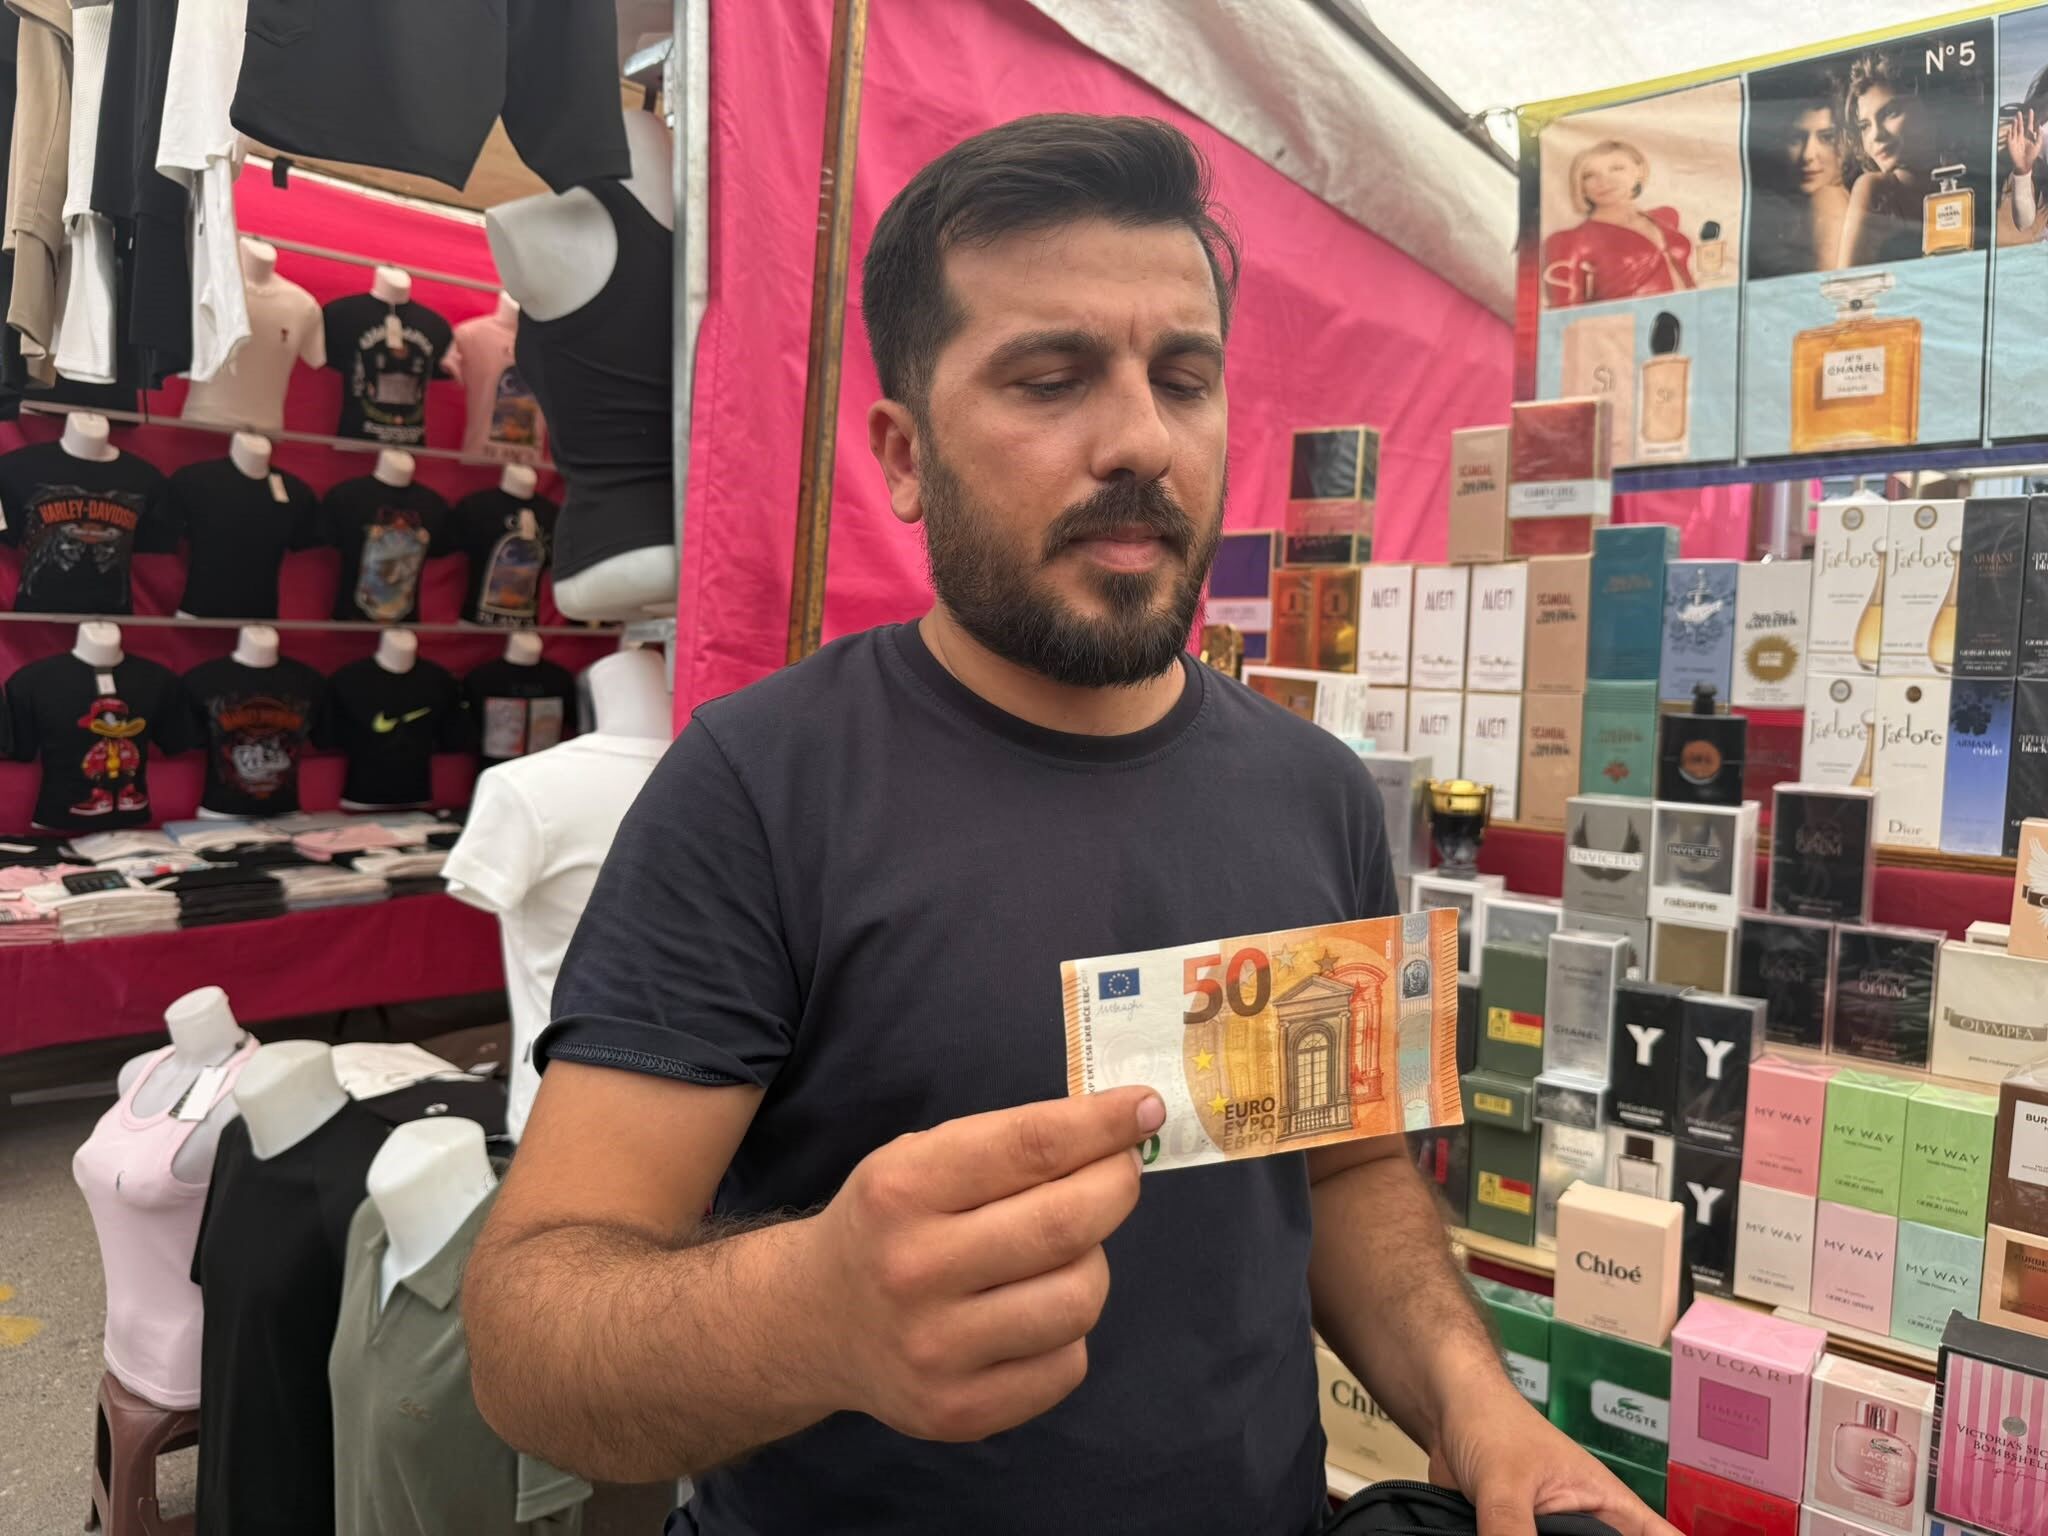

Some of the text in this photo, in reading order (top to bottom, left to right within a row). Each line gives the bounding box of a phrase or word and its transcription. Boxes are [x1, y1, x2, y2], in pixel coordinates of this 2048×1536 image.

[1826, 362, 1881, 377] CHANEL
[1888, 819, 1923, 836] Dior
[1663, 896, 1718, 911] rabanne
[1182, 947, 1272, 1025] 50
[1858, 983, 1908, 999] OPIUM
[1552, 1023, 1602, 1041] CHANEL
[1625, 1023, 1665, 1066] Y
[1696, 1036, 1736, 1081] Y
[1225, 1096, 1276, 1120] EURO
[1754, 1106, 1812, 1125] MY WAY
[1833, 1123, 1894, 1144] MY WAY
[1915, 1143, 1980, 1165] MY WAY
[1686, 1180, 1725, 1226] Y
[1745, 1222, 1803, 1243] MY WAY
[1823, 1239, 1884, 1261] MY WAY
[1575, 1250, 1643, 1284] Chloé
[1905, 1263, 1929, 1276] MY
[1933, 1269, 1969, 1287] WAY
[1681, 1344, 1793, 1385] BVLGARI
[1602, 1403, 1658, 1429] LACOSTE
[1957, 1423, 2023, 1451] VICTORIA'S
